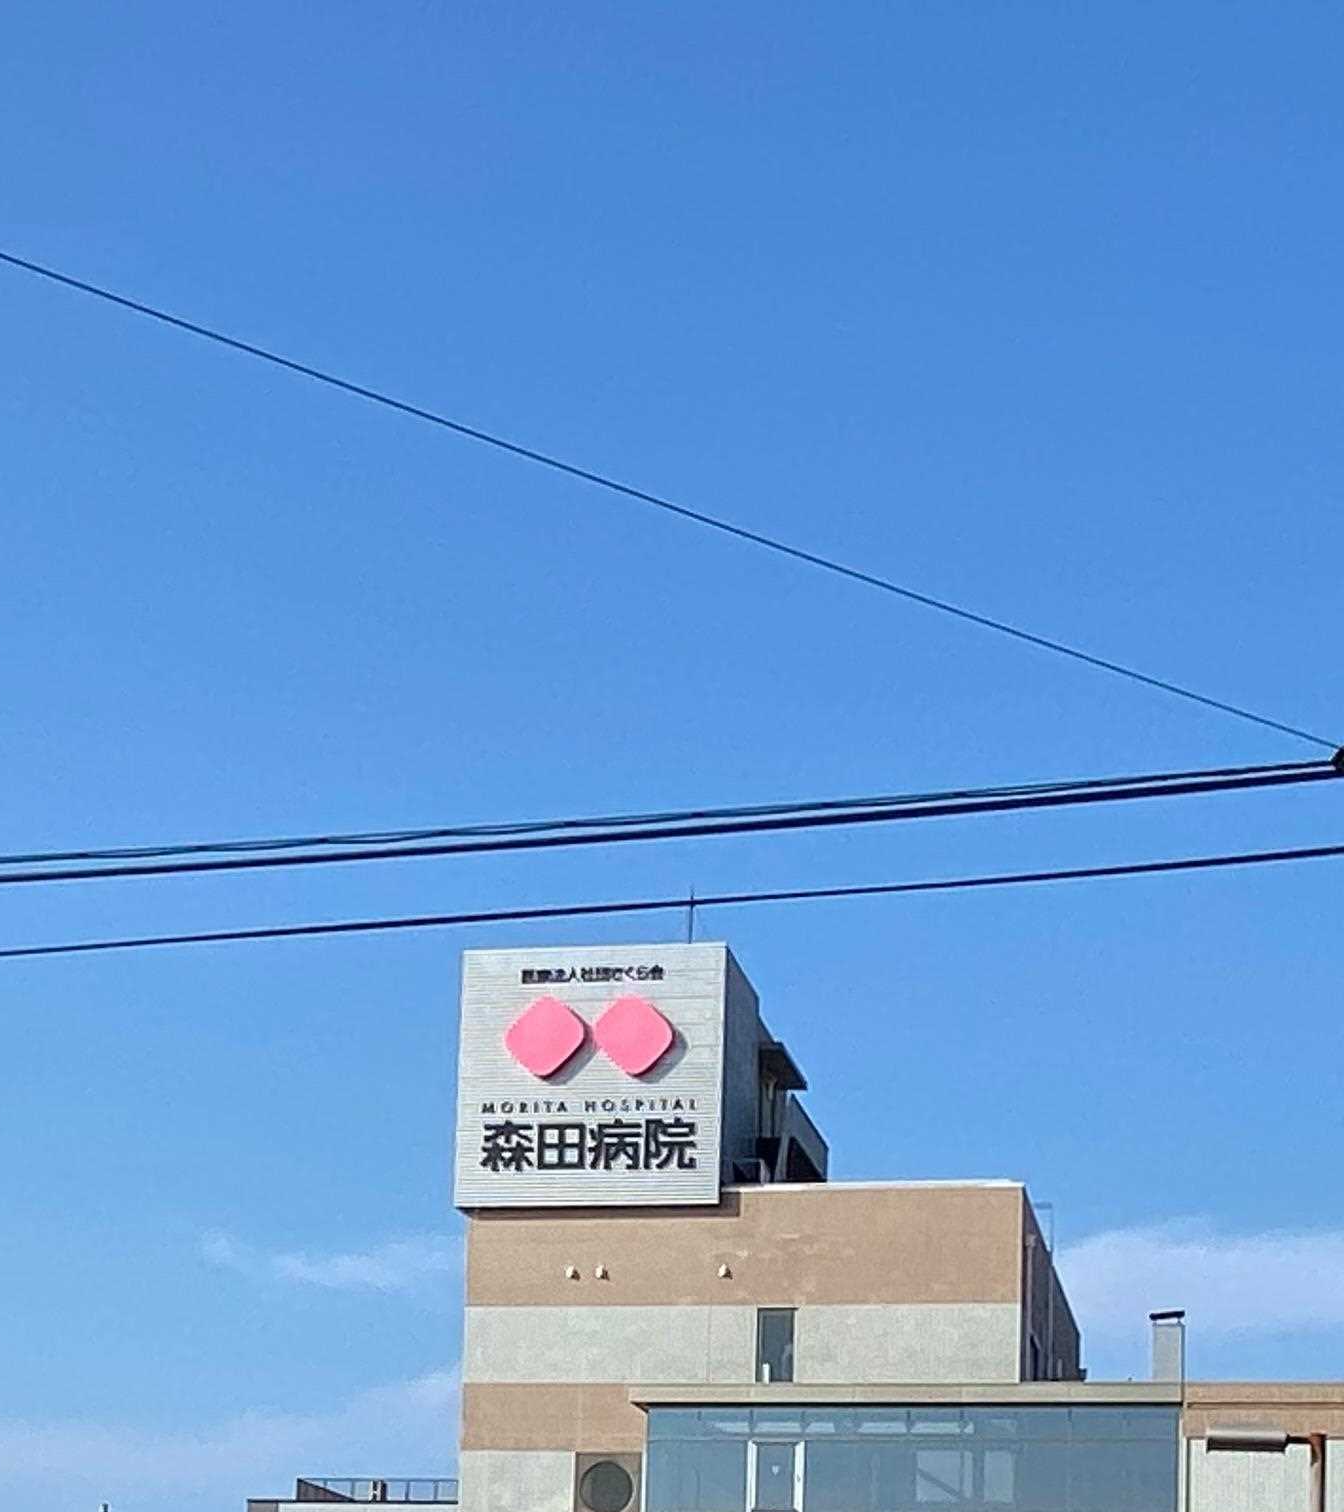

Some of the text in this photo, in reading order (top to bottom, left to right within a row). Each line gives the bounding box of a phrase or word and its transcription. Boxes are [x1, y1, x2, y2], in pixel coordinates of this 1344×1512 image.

[481, 1098, 698, 1114] MORITA HOSPITAL
[481, 1118, 698, 1171] 森田病院
